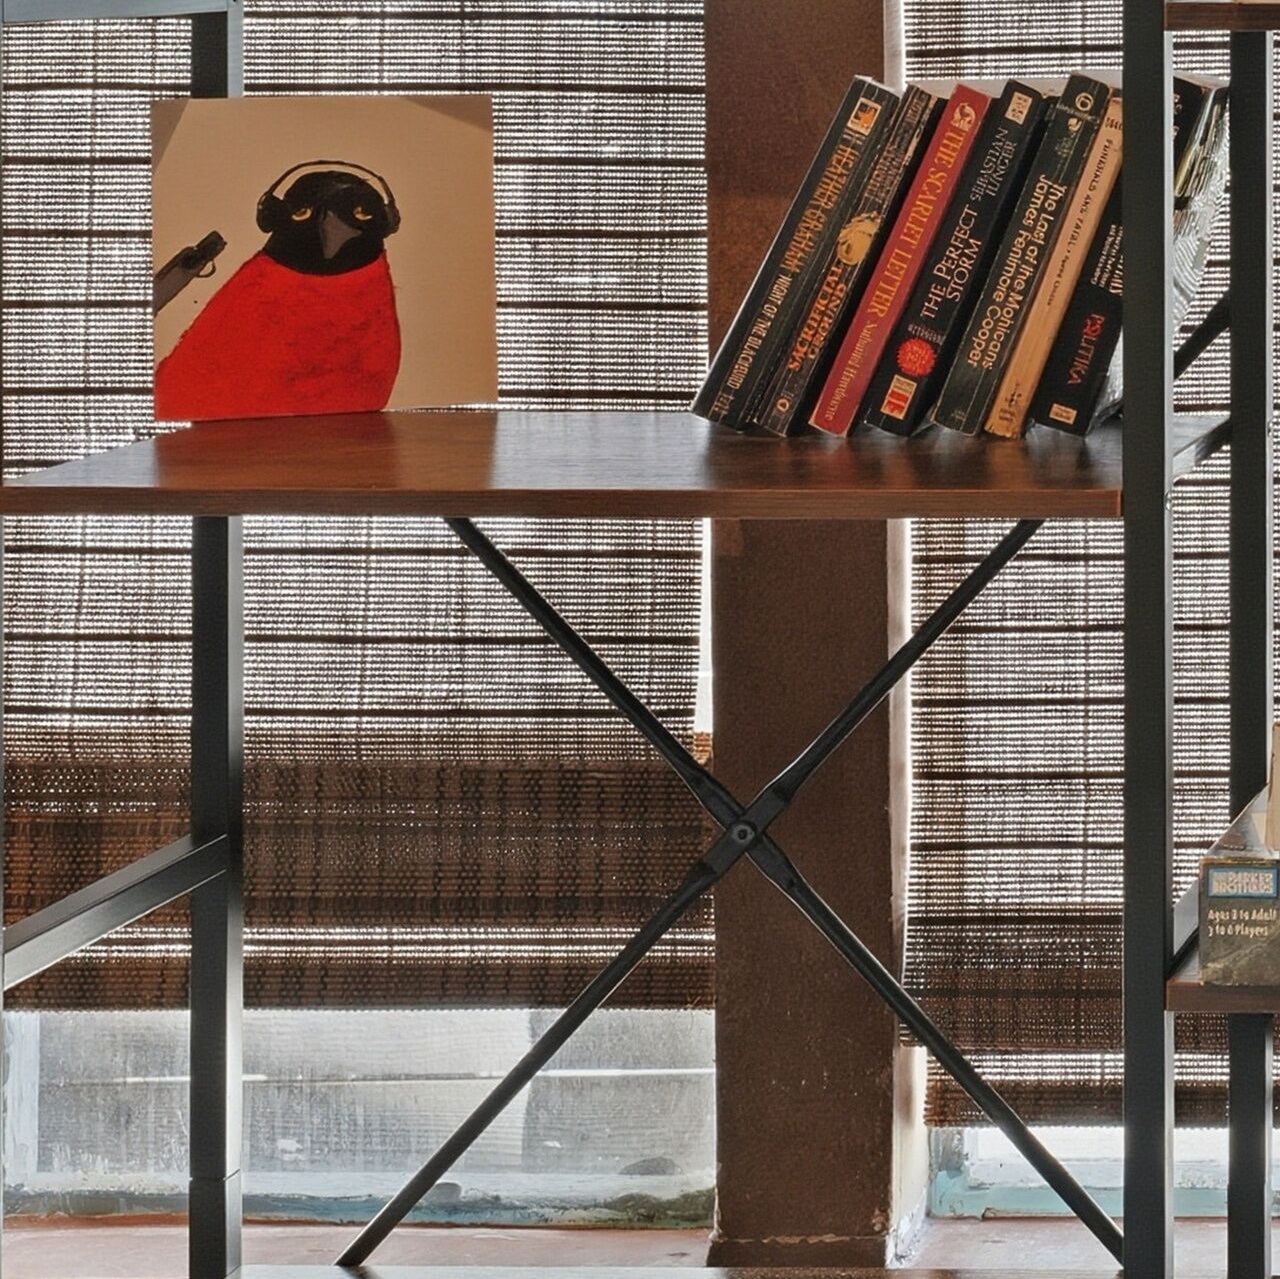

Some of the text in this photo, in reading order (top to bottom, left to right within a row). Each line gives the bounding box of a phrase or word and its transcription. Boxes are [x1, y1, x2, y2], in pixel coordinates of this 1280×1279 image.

[810, 142, 859, 214] HEATHER
[934, 126, 966, 168] THE
[968, 125, 1009, 203] SEBASTIAN
[780, 206, 828, 275] GRAHAM
[898, 166, 947, 249] SCARLET
[867, 247, 911, 318] LETTER
[921, 282, 946, 320] THE
[941, 203, 980, 282] PERFECT
[945, 236, 982, 302] STORM
[964, 172, 1053, 368] James Fenimore Cooper
[981, 182, 1065, 372] The Last of the Mohicans
[751, 316, 771, 337] THE
[760, 302, 778, 318] OF
[786, 260, 844, 373] SACRIFICIAL
[805, 281, 848, 360] GROUND
[1234, 924, 1269, 938] Players
